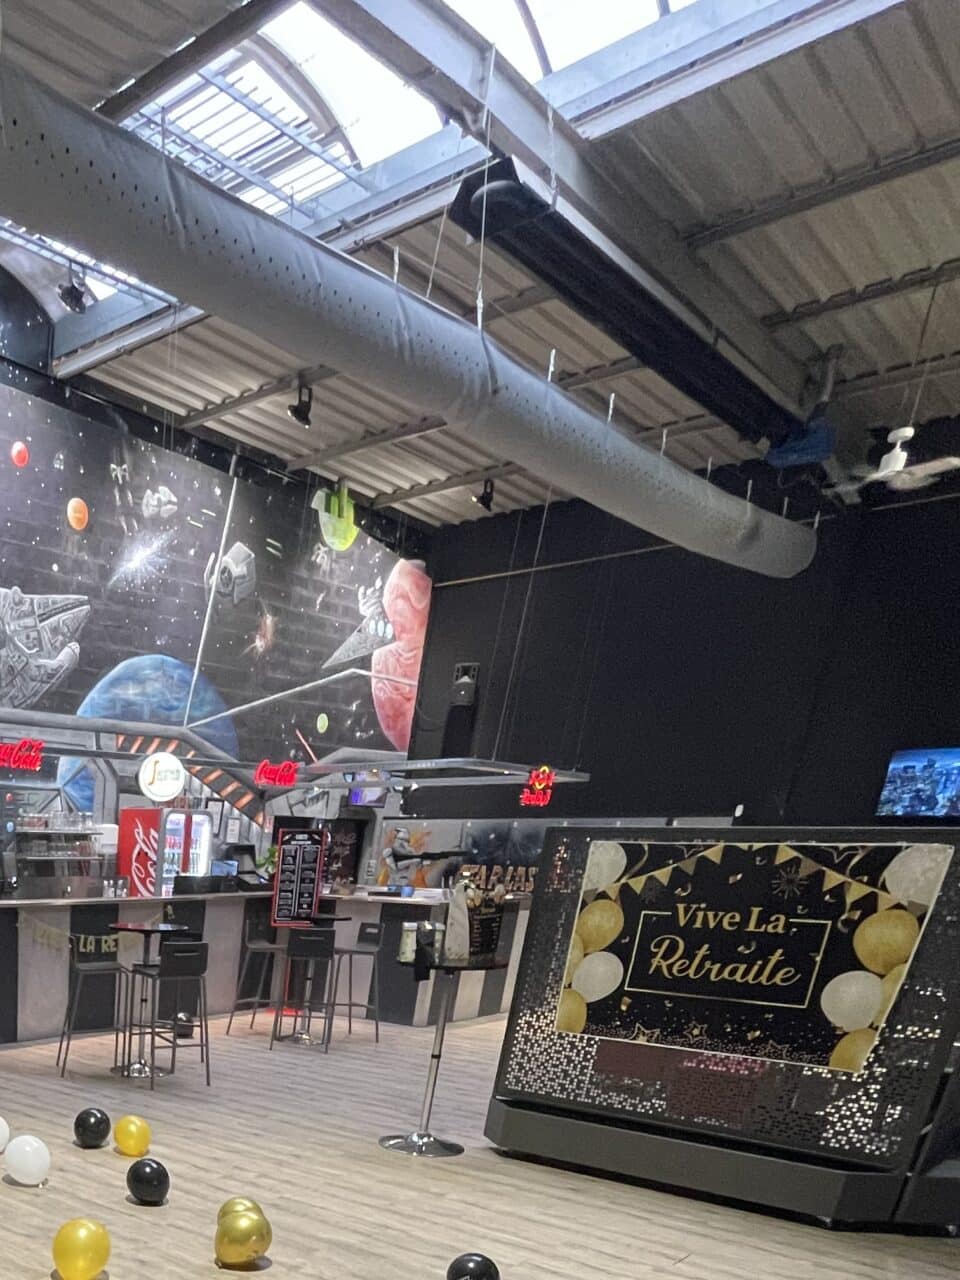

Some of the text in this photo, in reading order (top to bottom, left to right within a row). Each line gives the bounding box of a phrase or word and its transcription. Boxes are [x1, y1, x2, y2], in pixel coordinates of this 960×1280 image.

[676, 903, 786, 934] Vive La
[79, 934, 95, 953] LA
[648, 935, 802, 986] Retraite
